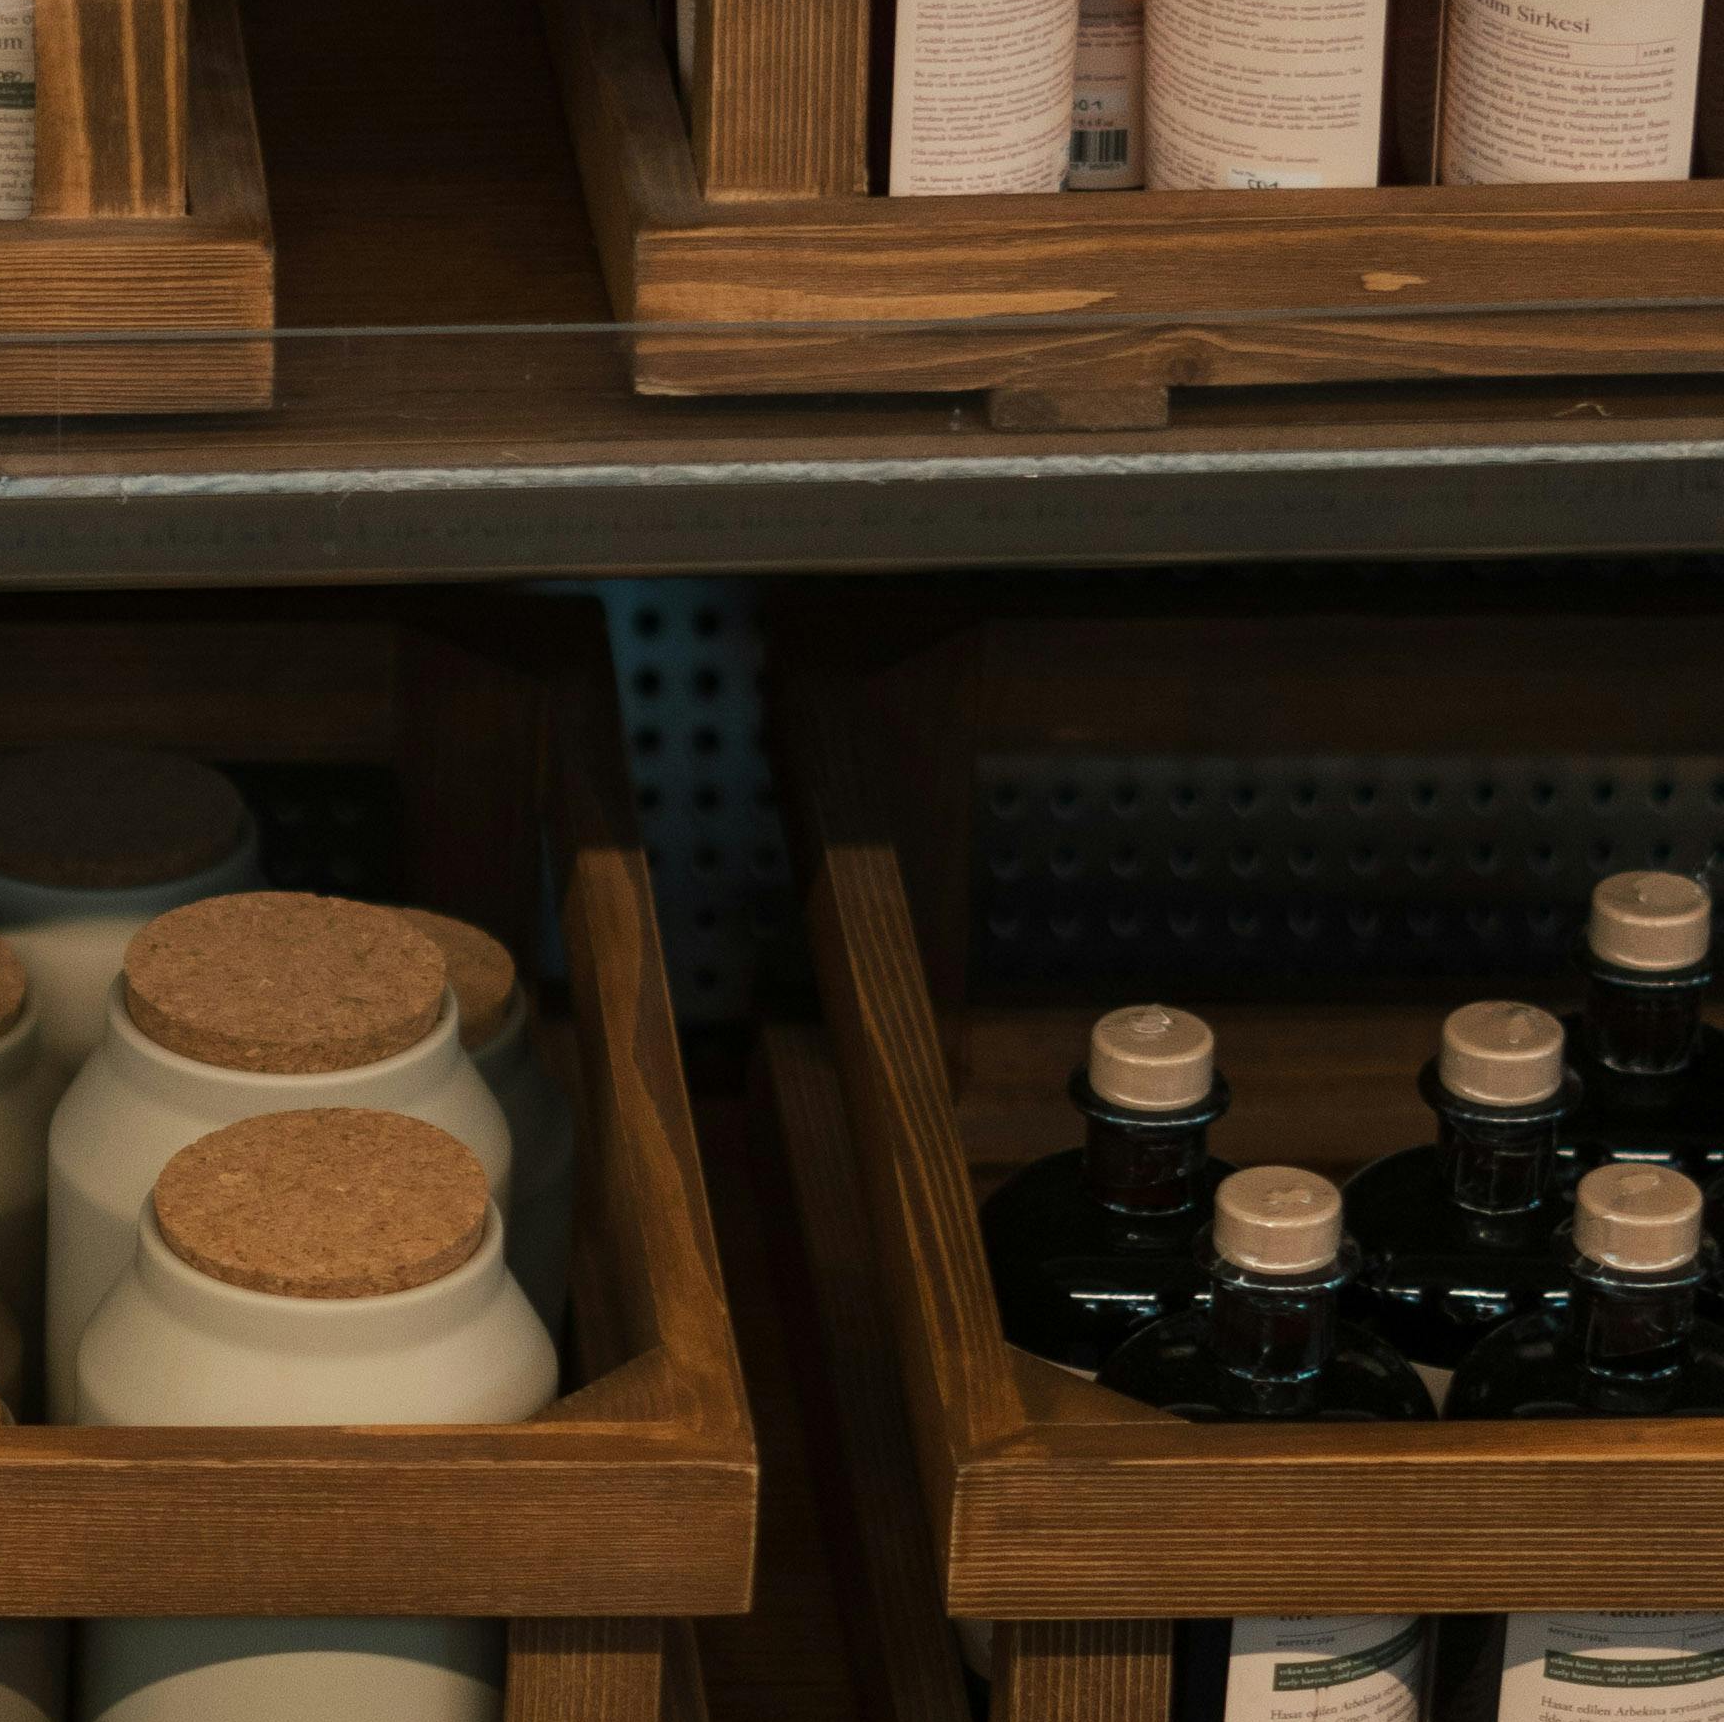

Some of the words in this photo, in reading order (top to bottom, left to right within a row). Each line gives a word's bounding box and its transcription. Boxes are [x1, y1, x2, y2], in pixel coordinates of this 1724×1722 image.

[1516, 4, 1592, 35] Sirkesi
[1606, 1673, 1626, 1684] cold
[1540, 1695, 1573, 1713] Hasat
[1576, 1700, 1611, 1716] edilen
[1613, 1701, 1667, 1717] Arbekina
[1269, 1709, 1303, 1720] Hasat
